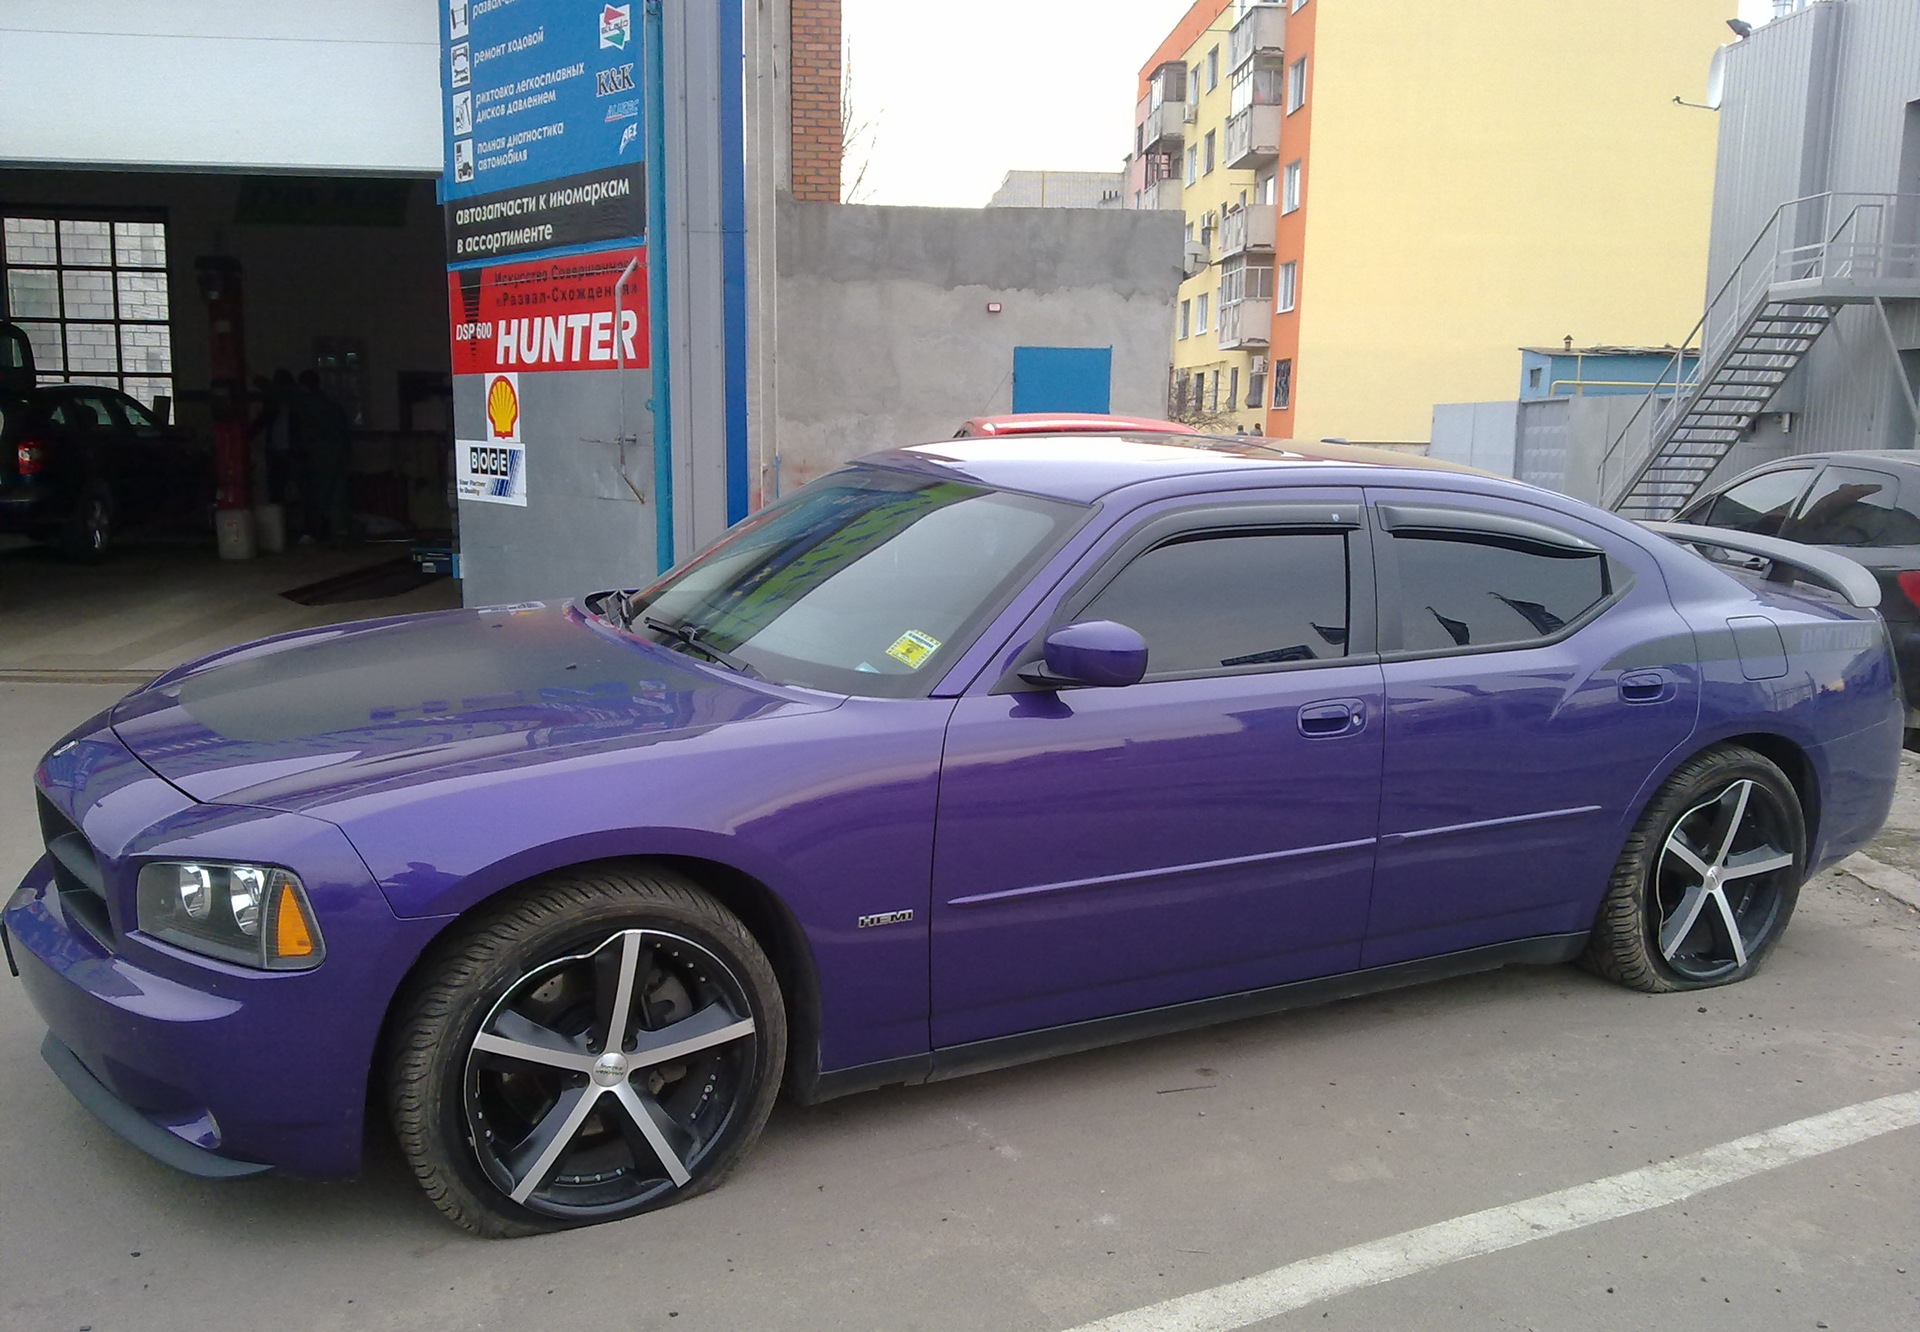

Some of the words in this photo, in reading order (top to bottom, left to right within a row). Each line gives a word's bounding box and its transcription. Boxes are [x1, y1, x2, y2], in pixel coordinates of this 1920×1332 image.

[473, 43, 506, 67] ремонт
[507, 26, 544, 53] ходовой
[475, 85, 514, 108] рихтовка
[515, 63, 584, 95] легкосплавных
[596, 63, 635, 97] K&K
[476, 104, 506, 123] дисков
[507, 90, 557, 115] давлением
[477, 137, 506, 154] полная
[507, 122, 564, 147] диагностика
[478, 149, 528, 171] автомобиля
[455, 198, 536, 225] автозапчасти
[549, 177, 630, 207] иномаркам
[456, 238, 464, 254] в
[465, 223, 553, 253] ассортименте
[455, 323, 476, 341] DSP
[476, 322, 492, 339] 600
[496, 309, 638, 365] HUNTER
[470, 450, 507, 473] BOGE
[1801, 625, 1873, 652] DAYTONA
[858, 908, 914, 929] HEMI
